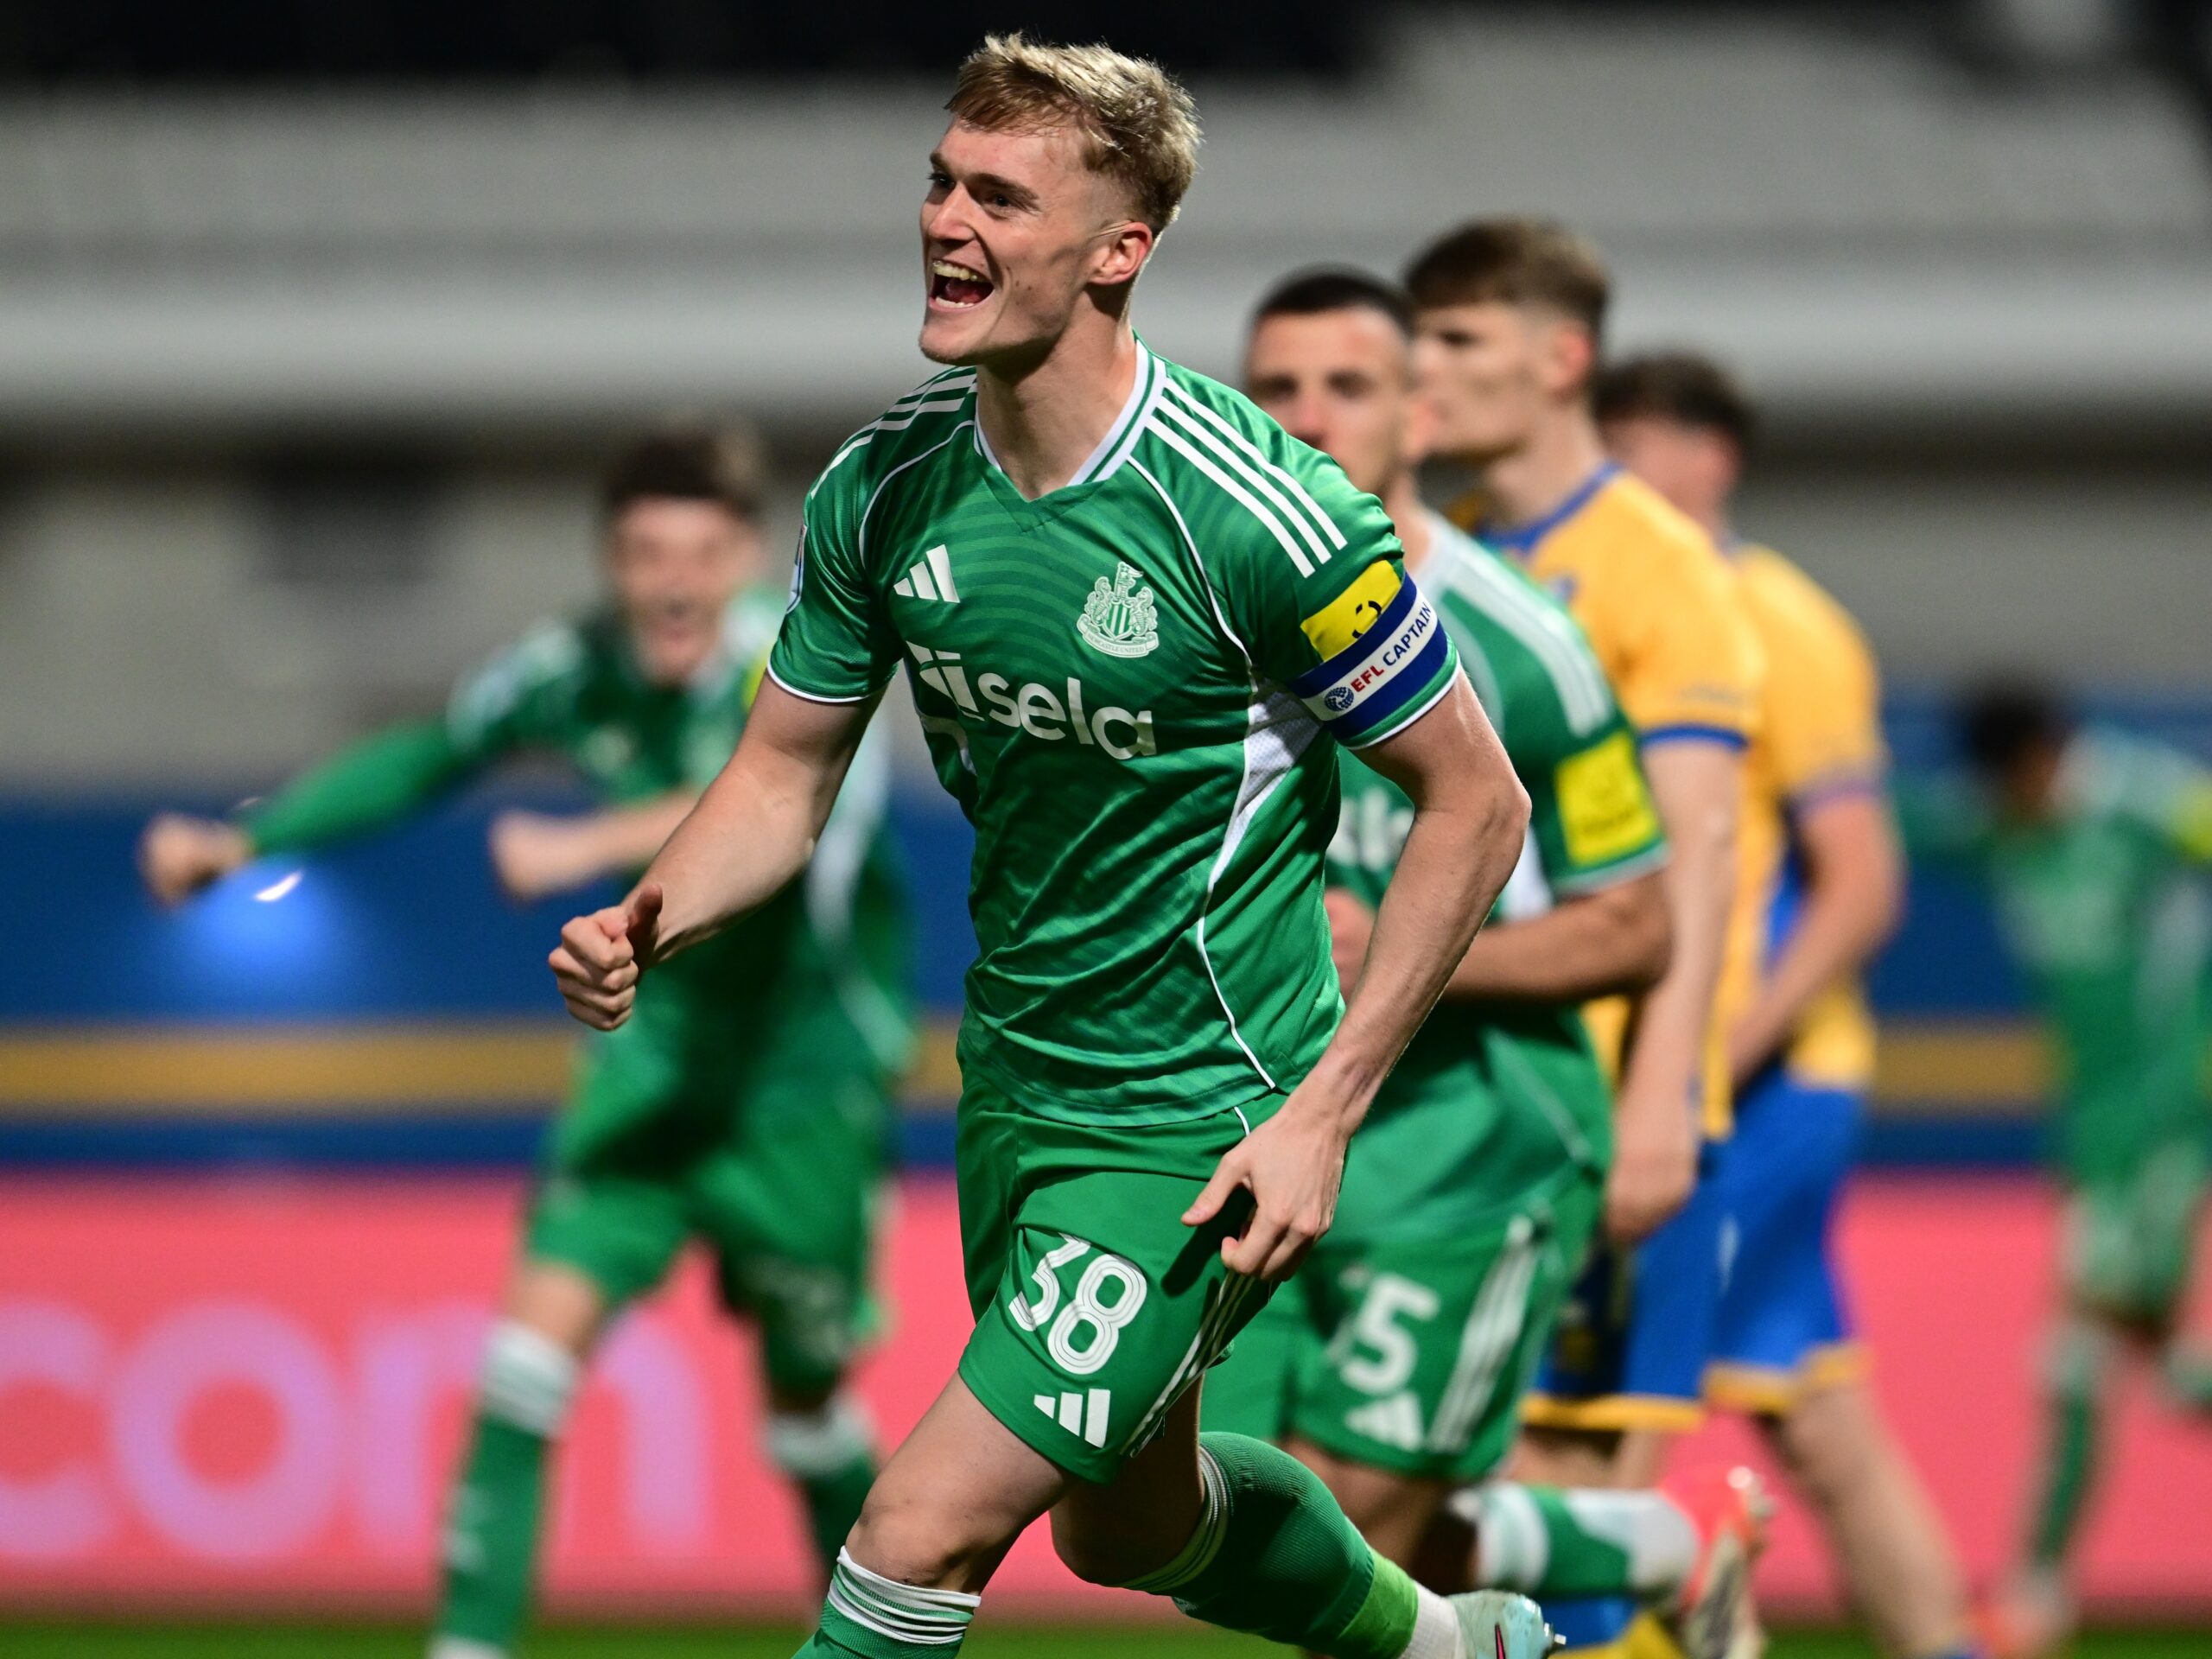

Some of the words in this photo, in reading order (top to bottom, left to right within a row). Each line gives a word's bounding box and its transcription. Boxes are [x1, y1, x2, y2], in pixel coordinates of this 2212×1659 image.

[1351, 665, 1384, 692] EFL
[1382, 601, 1432, 666] CAPTAIN
[977, 672, 1157, 760] sela
[1008, 1232, 1148, 1376] 38
[1325, 1262, 1443, 1396] 5
